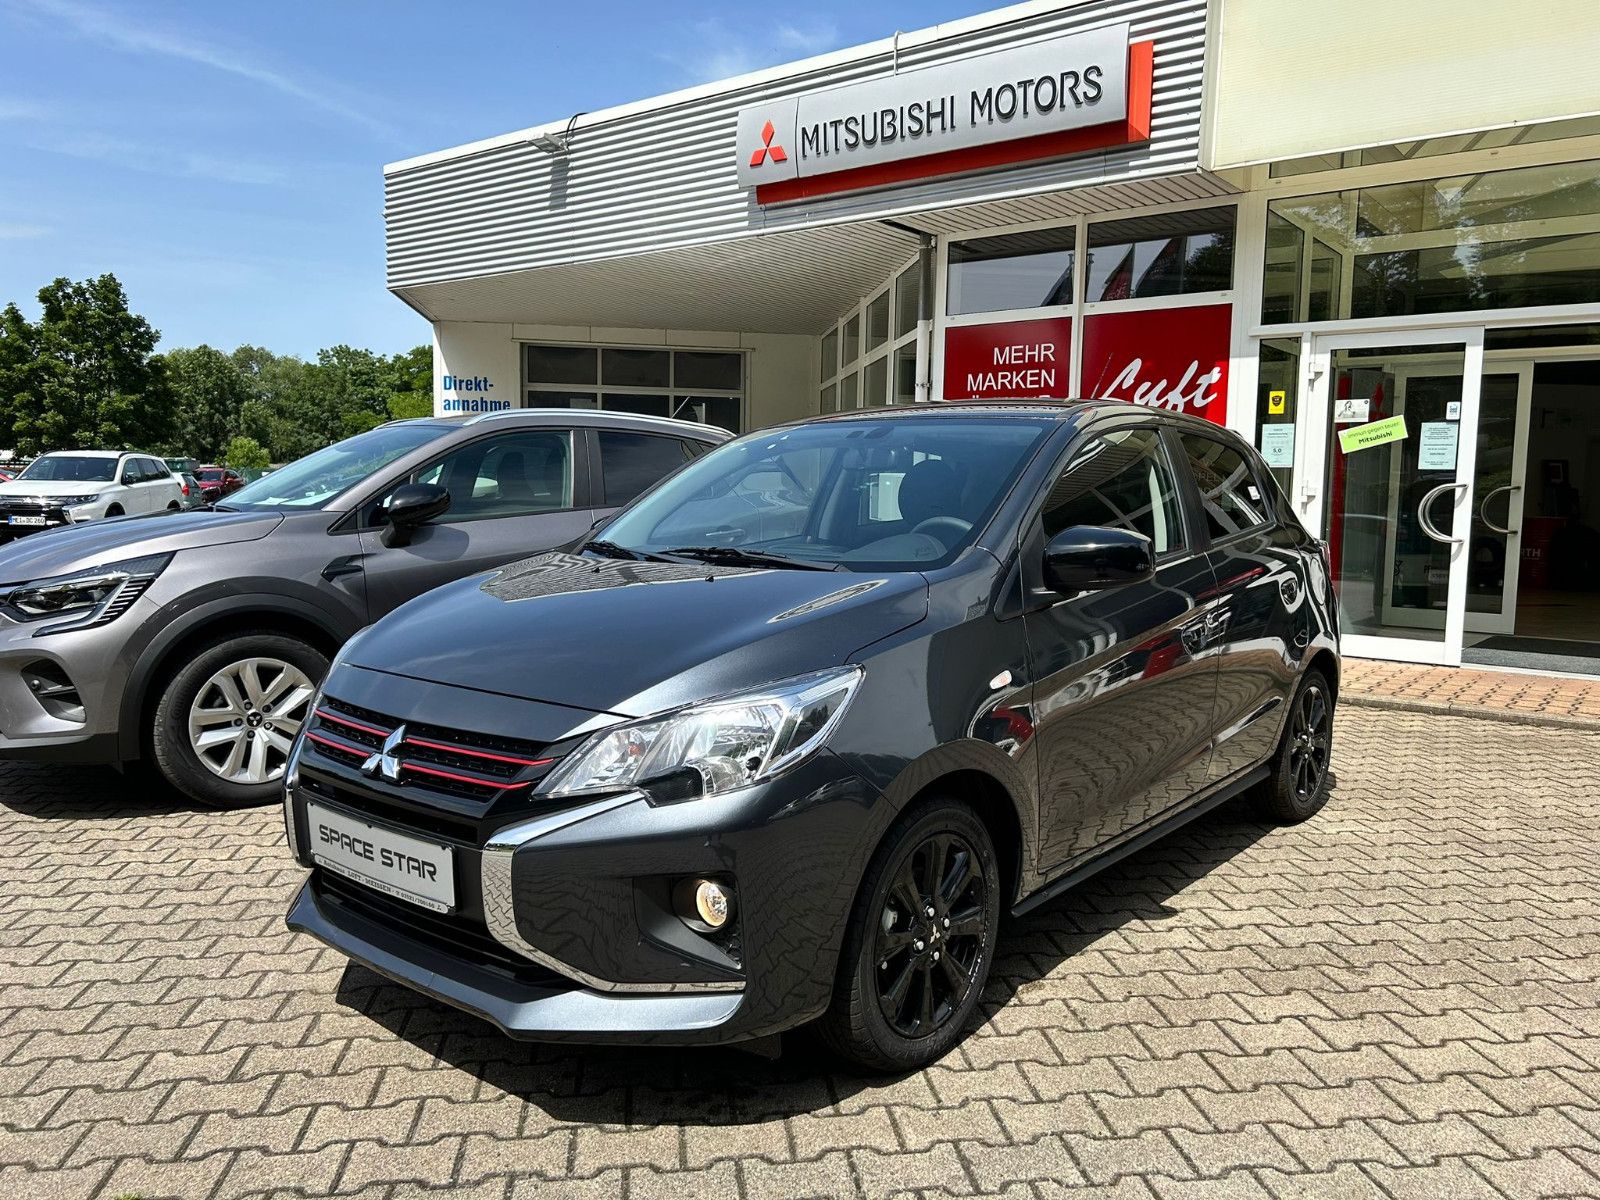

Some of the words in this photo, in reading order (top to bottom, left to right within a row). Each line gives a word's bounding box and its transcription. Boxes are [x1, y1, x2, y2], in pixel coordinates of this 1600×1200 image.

[801, 95, 956, 158] MITSUBISHI
[970, 65, 1103, 126] MOTORS
[993, 343, 1056, 366] MEHR
[443, 375, 494, 392] Direkt-
[967, 368, 1056, 392] MARKEN
[1099, 357, 1222, 412] Luft
[443, 397, 511, 412] annahme
[1358, 430, 1393, 445] Mitsubishi
[319, 823, 375, 862] SPACE
[380, 847, 437, 883] STAR
